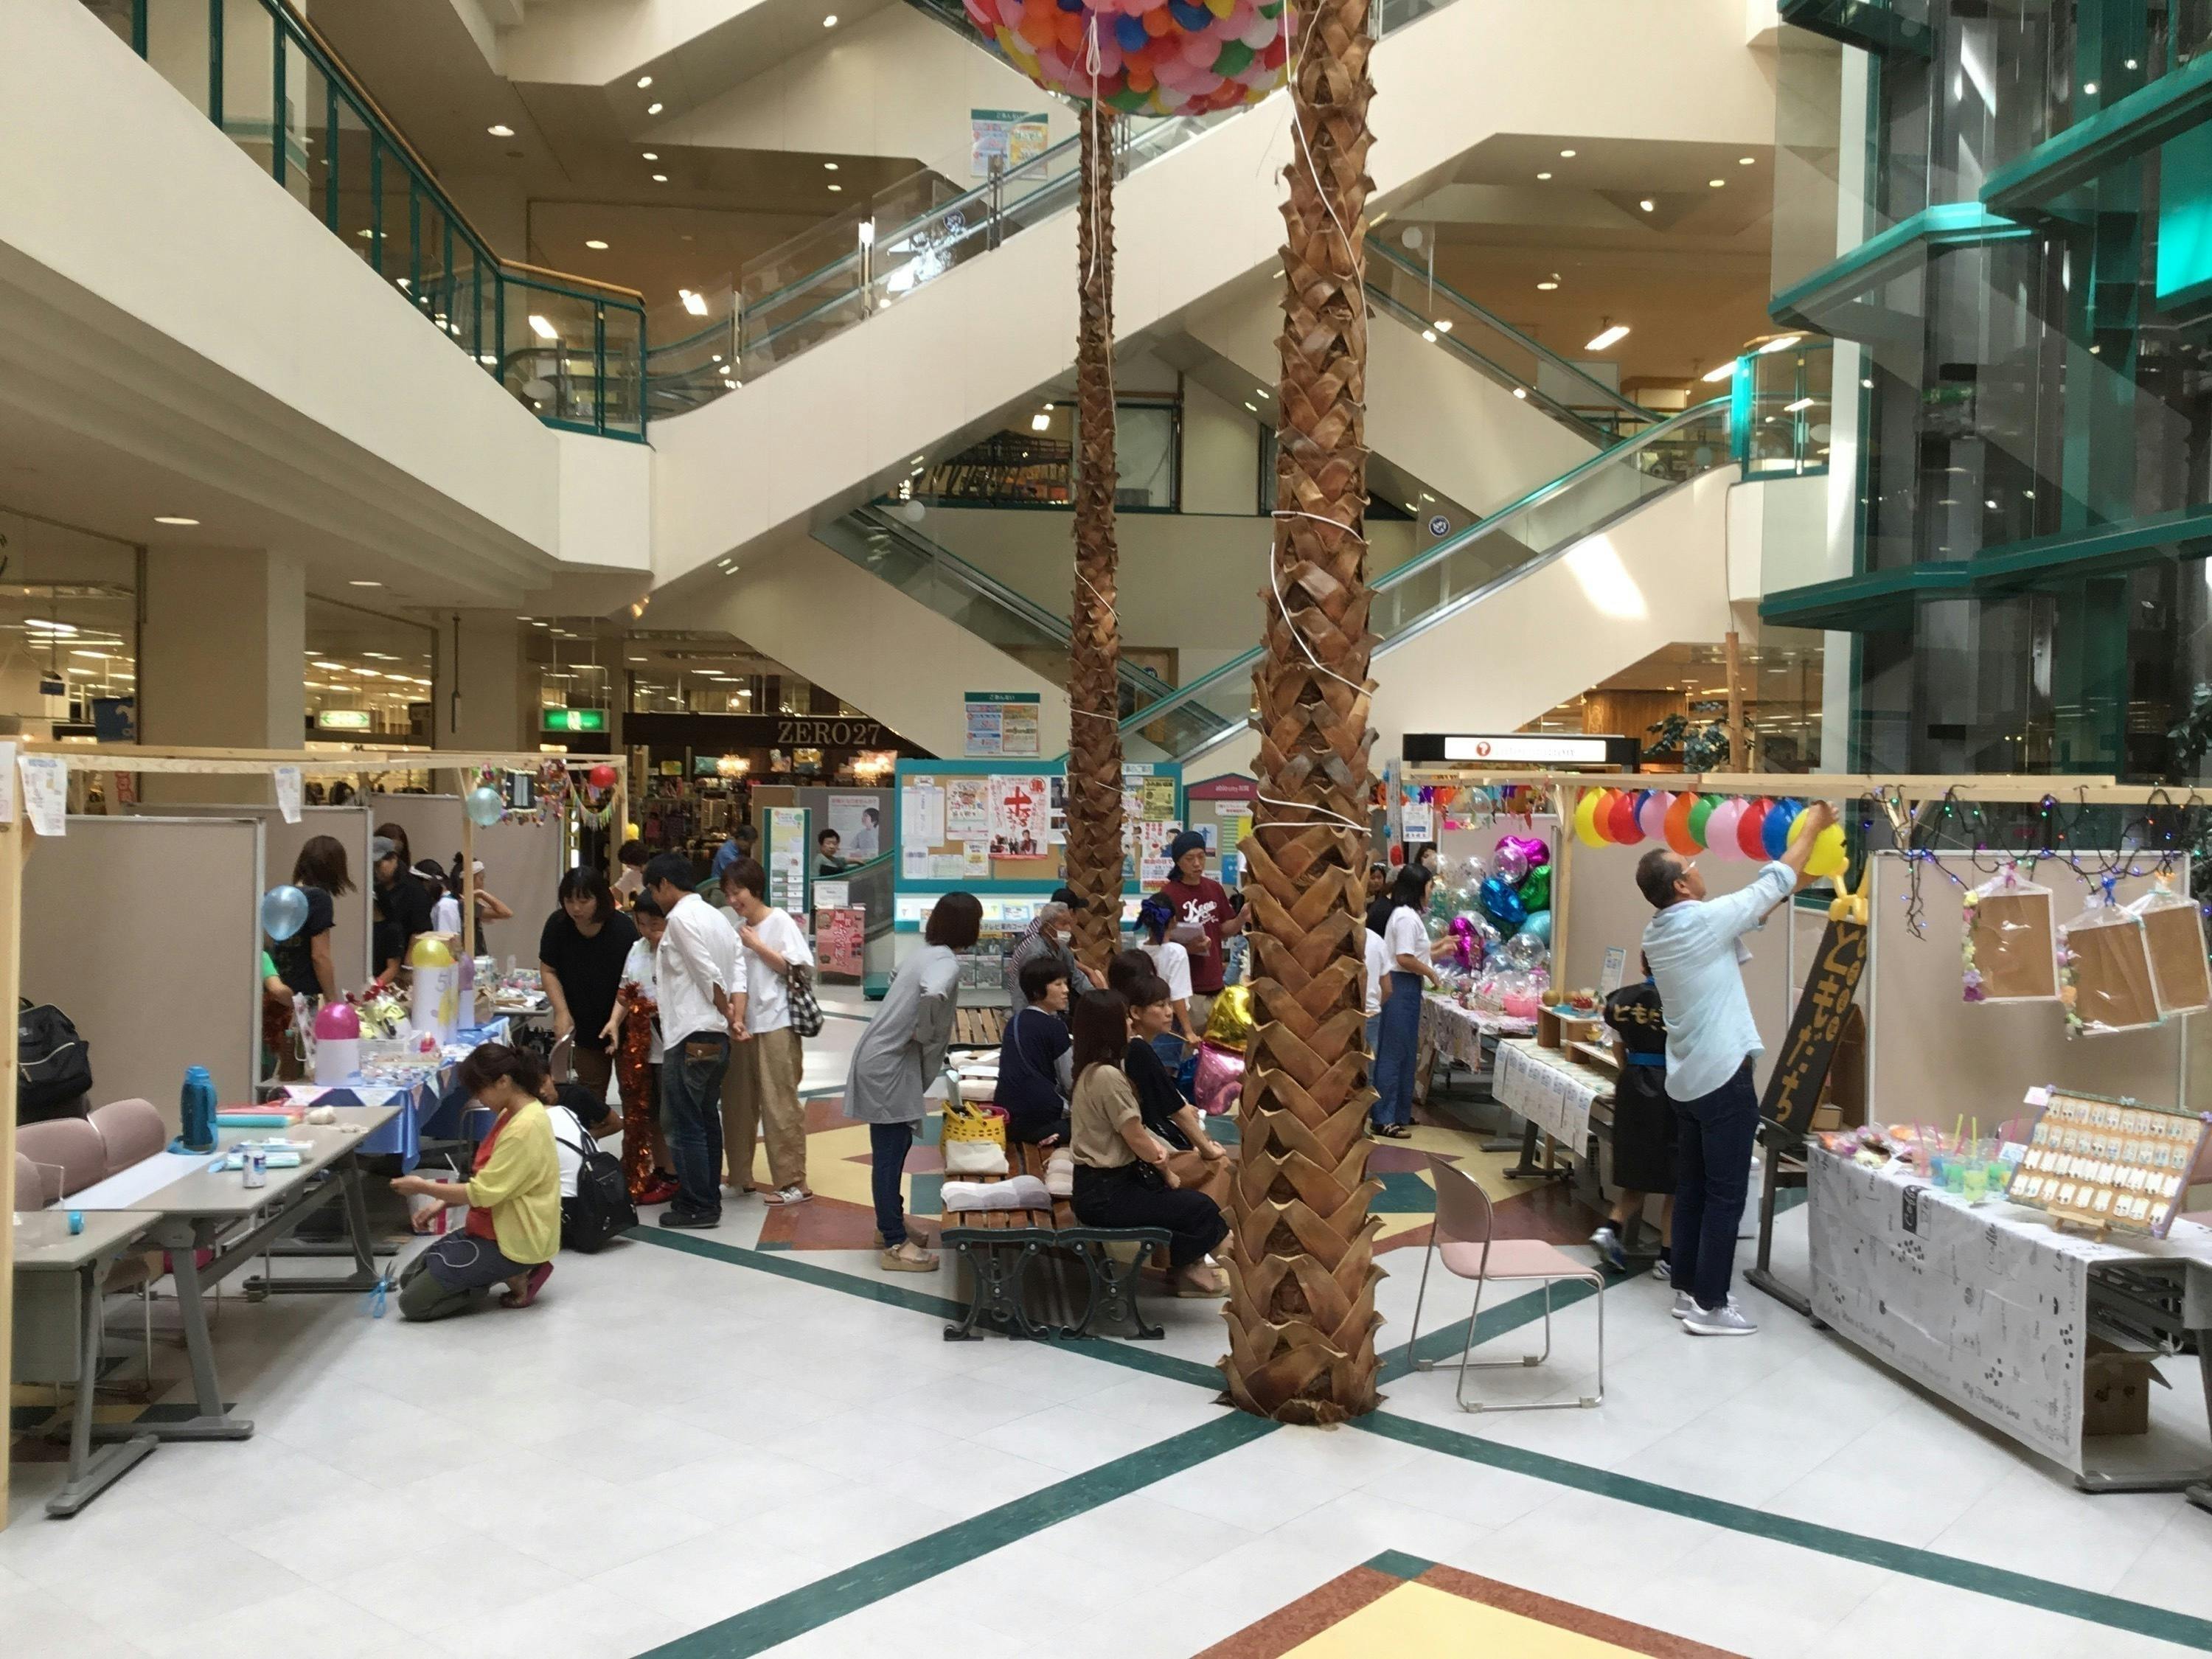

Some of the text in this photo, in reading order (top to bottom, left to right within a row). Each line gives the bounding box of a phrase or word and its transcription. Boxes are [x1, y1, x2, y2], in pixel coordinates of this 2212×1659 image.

[777, 721, 880, 745] ZERO27
[1775, 924, 1860, 1123] ともだち
